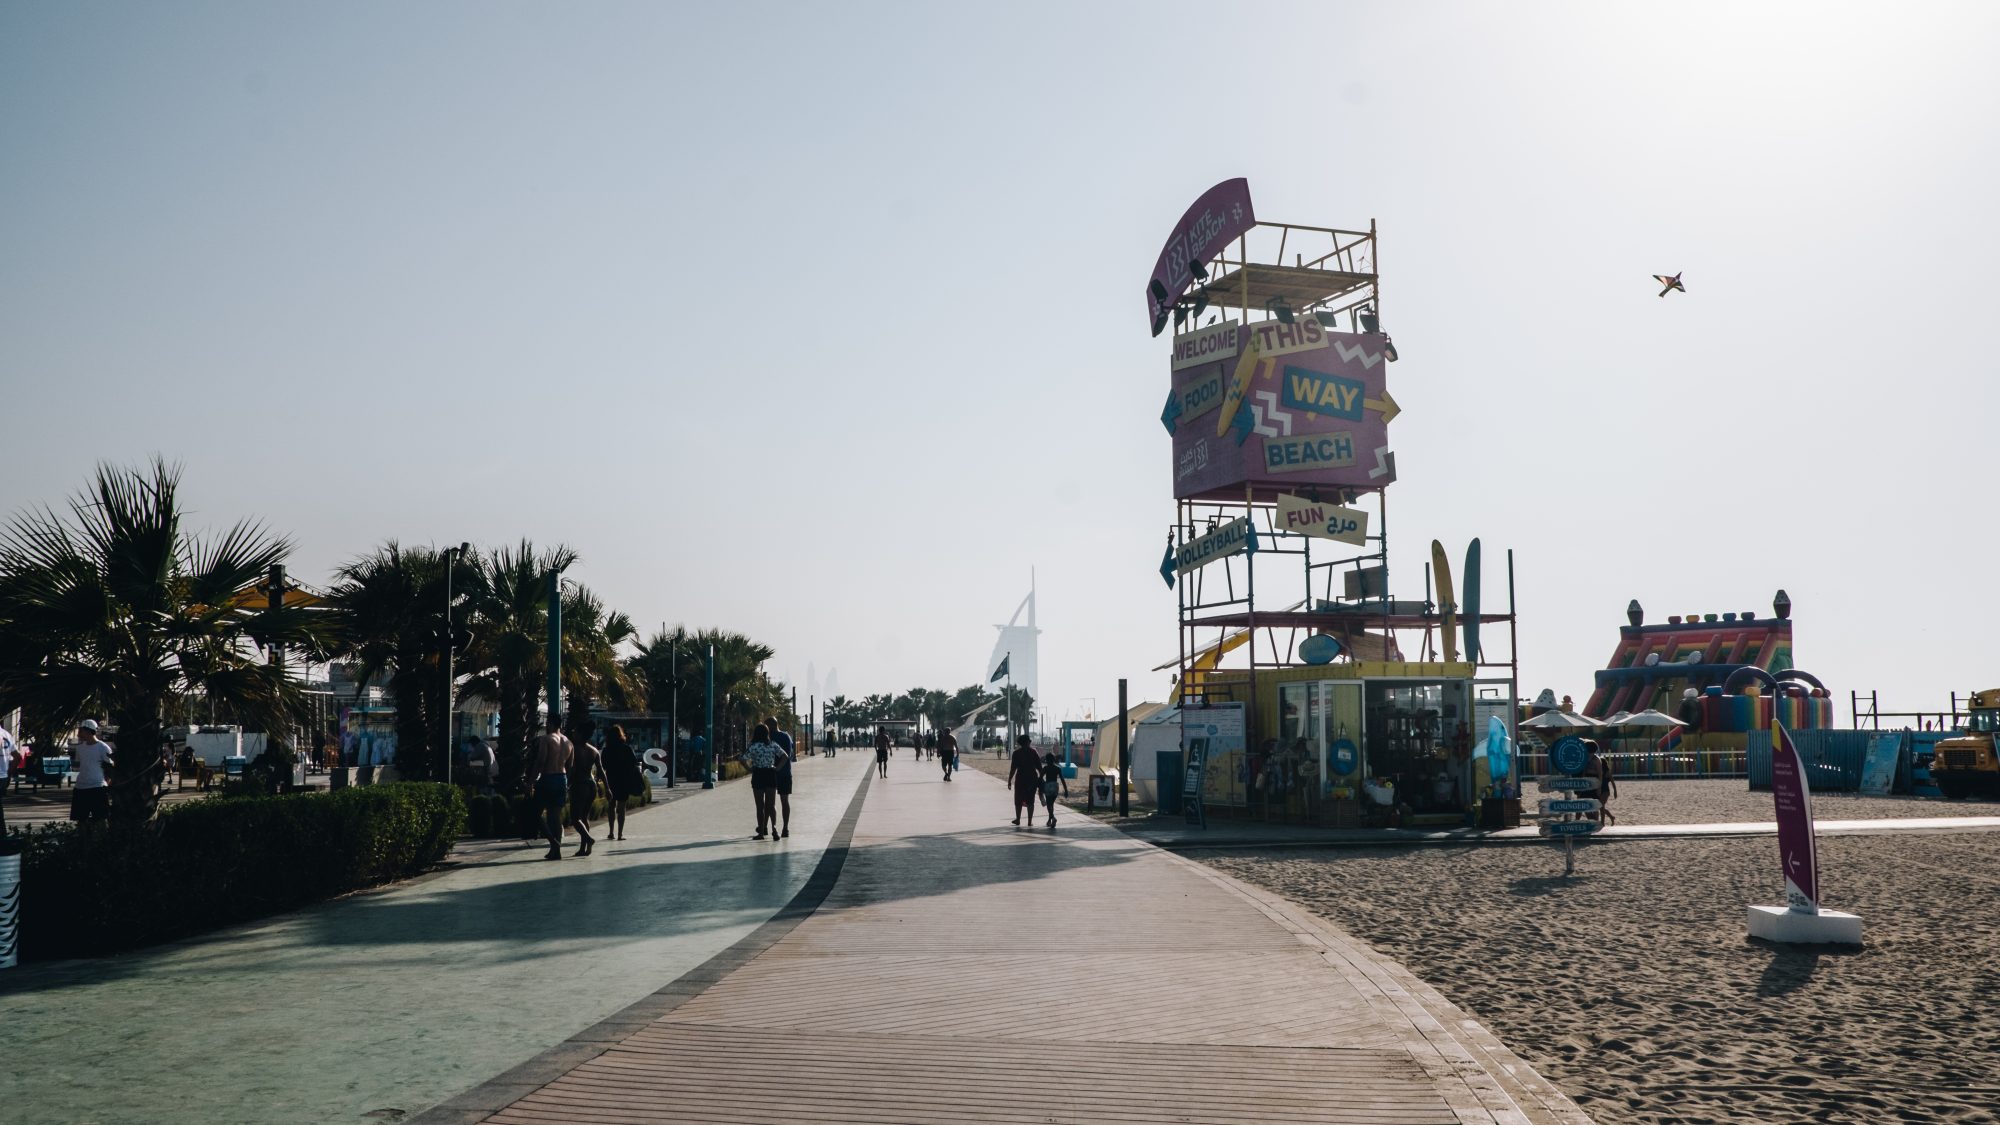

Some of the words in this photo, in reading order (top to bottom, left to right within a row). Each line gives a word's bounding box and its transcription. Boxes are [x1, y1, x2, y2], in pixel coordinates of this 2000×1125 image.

[1189, 208, 1213, 243] KITE
[1191, 211, 1226, 258] BEACH
[1174, 328, 1236, 362] WELCOME
[1257, 318, 1323, 351] THIS
[1184, 379, 1219, 409] FOOD
[1291, 374, 1360, 412] WAY
[1268, 437, 1353, 466] BEACH
[1286, 506, 1325, 528] FUN
[1177, 525, 1245, 567] VOLLEYBALL
[1550, 780, 1590, 788] UMBRELLAS
[1553, 801, 1591, 810] LOUNGERS
